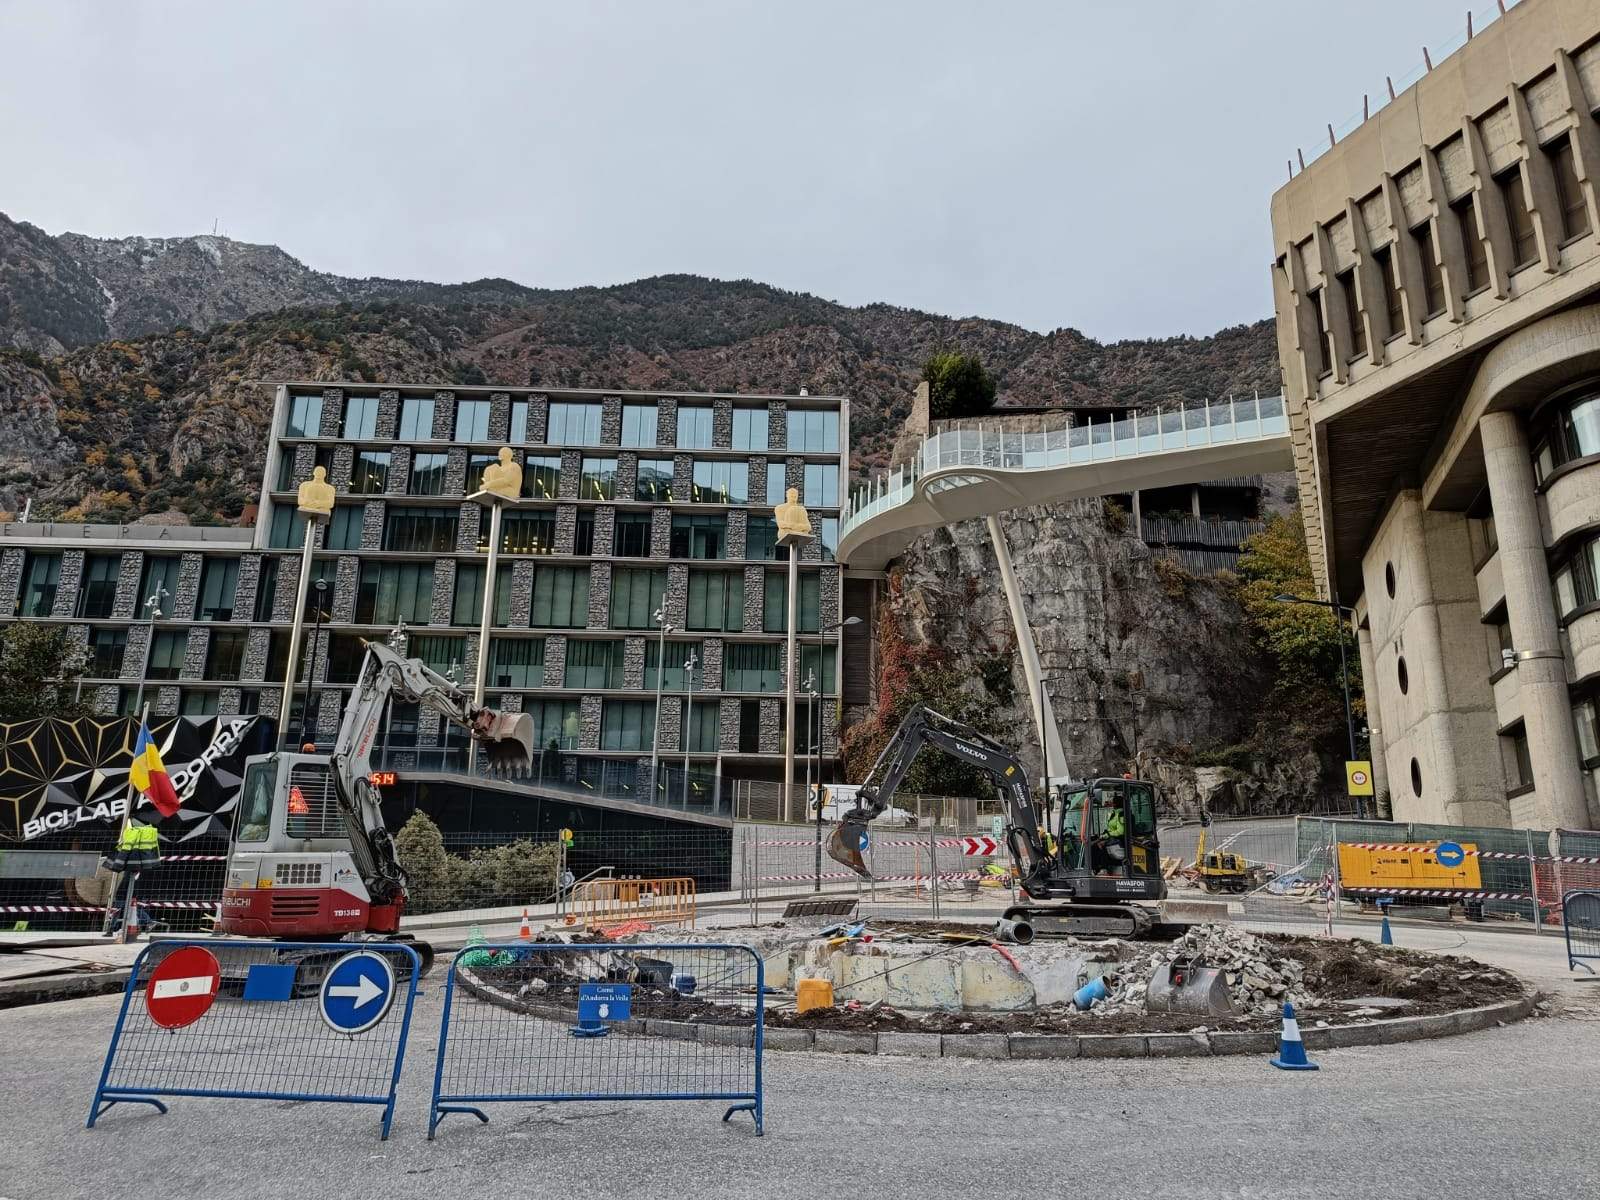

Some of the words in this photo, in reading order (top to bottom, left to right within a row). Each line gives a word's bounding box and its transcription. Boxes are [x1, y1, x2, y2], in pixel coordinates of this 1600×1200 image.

[23, 809, 69, 840] BICI
[76, 798, 128, 823] LAB
[137, 719, 249, 809] ADORRA
[955, 742, 988, 761] VOLVO
